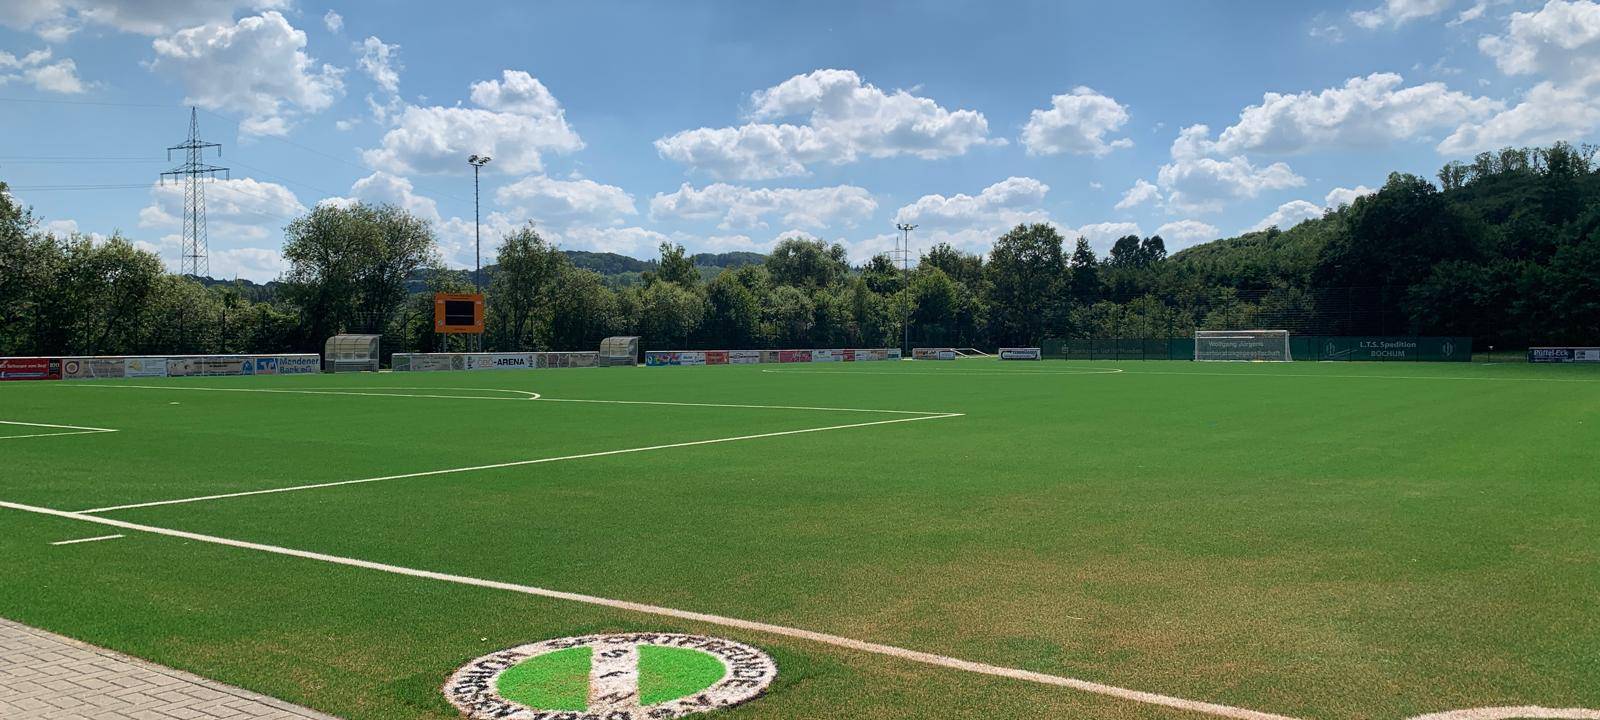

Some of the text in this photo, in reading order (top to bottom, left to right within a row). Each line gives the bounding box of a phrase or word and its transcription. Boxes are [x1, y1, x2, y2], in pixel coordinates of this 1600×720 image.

[1380, 341, 1417, 349] Spedition
[280, 366, 299, 374] Bank
[546, 633, 767, 688] SPORTFREUNDE
